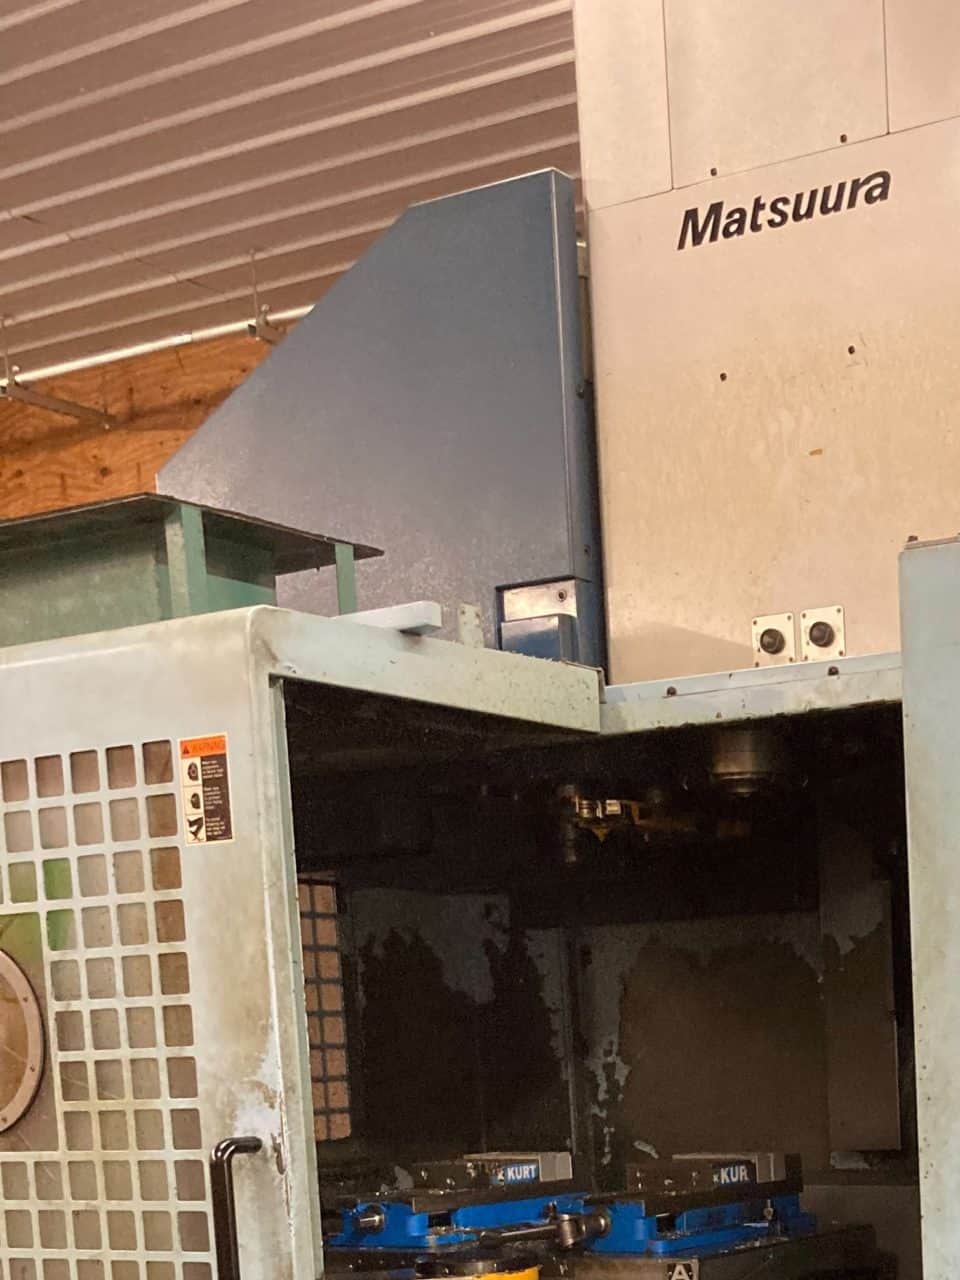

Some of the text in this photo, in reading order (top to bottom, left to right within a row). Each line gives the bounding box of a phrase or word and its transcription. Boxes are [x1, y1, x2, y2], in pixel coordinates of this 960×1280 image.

[677, 170, 892, 251] Matsuura
[507, 1164, 537, 1181] KURT
[720, 1165, 749, 1184] KUR
